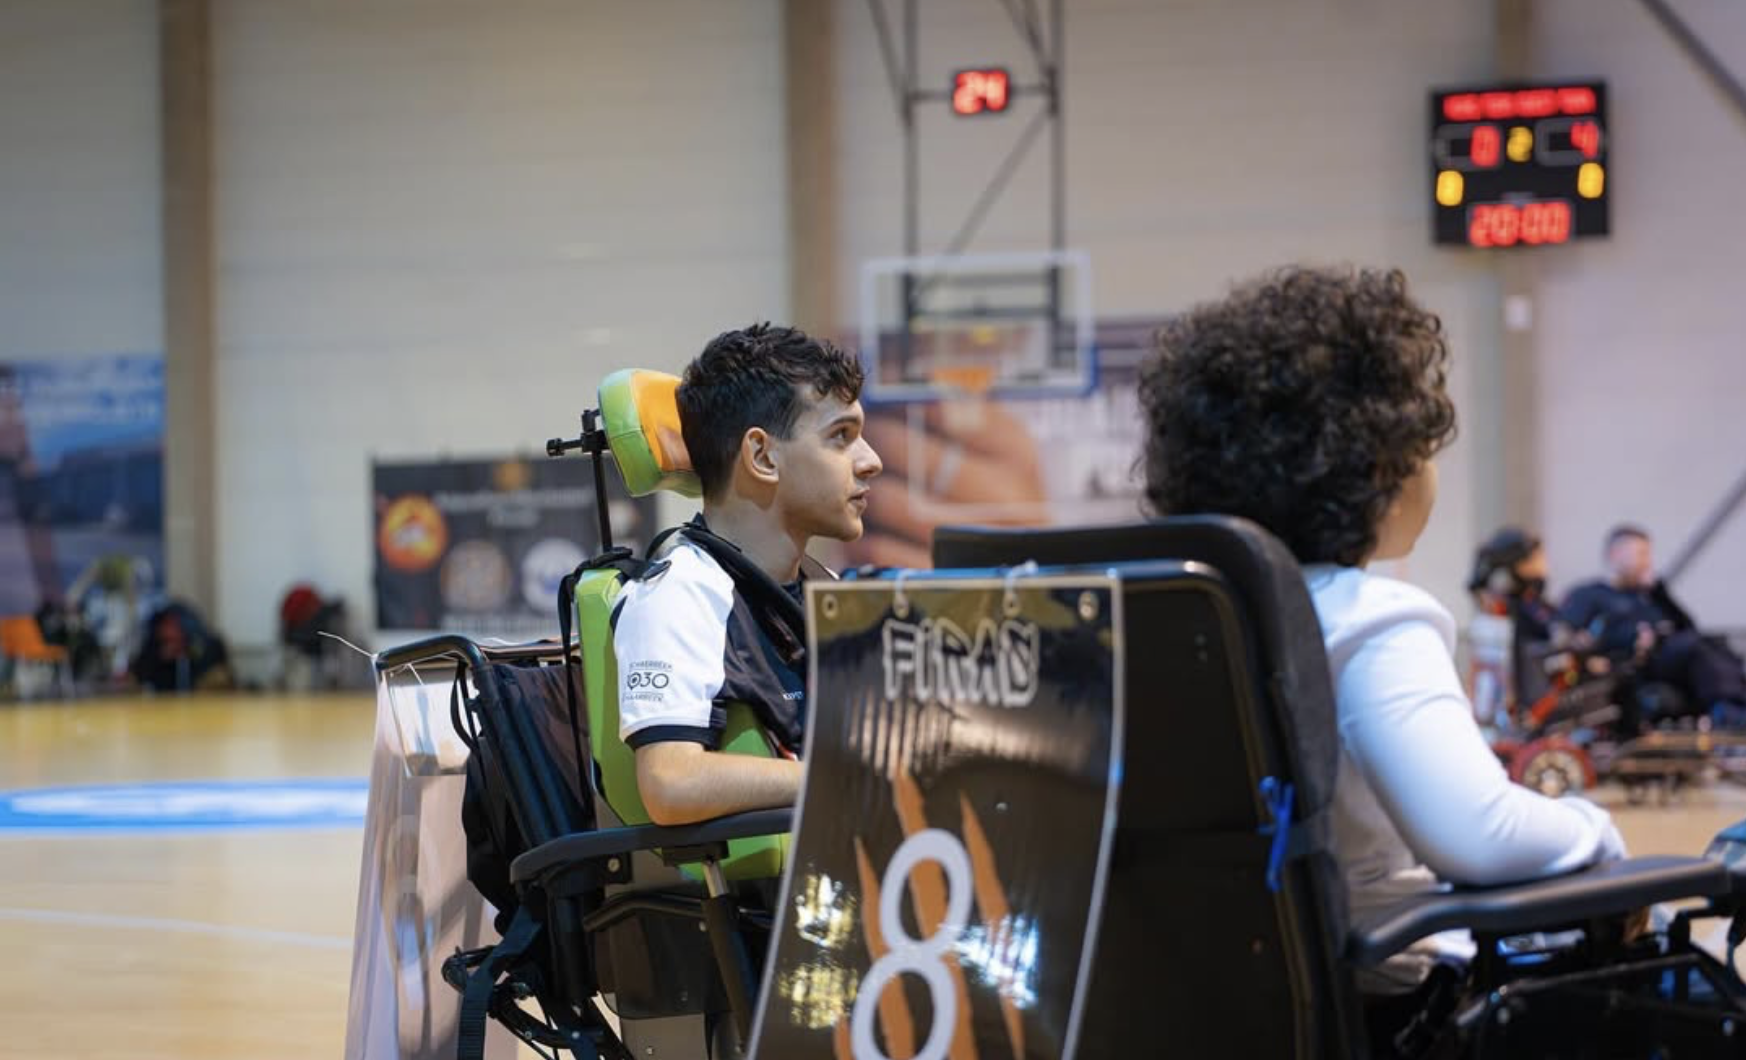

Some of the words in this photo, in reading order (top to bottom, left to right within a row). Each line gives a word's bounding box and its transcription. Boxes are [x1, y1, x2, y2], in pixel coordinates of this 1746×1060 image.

[953, 70, 1008, 115] 24
[1470, 125, 1500, 167] 0
[1469, 201, 1572, 248] 20:00
[851, 828, 975, 1060] 8
